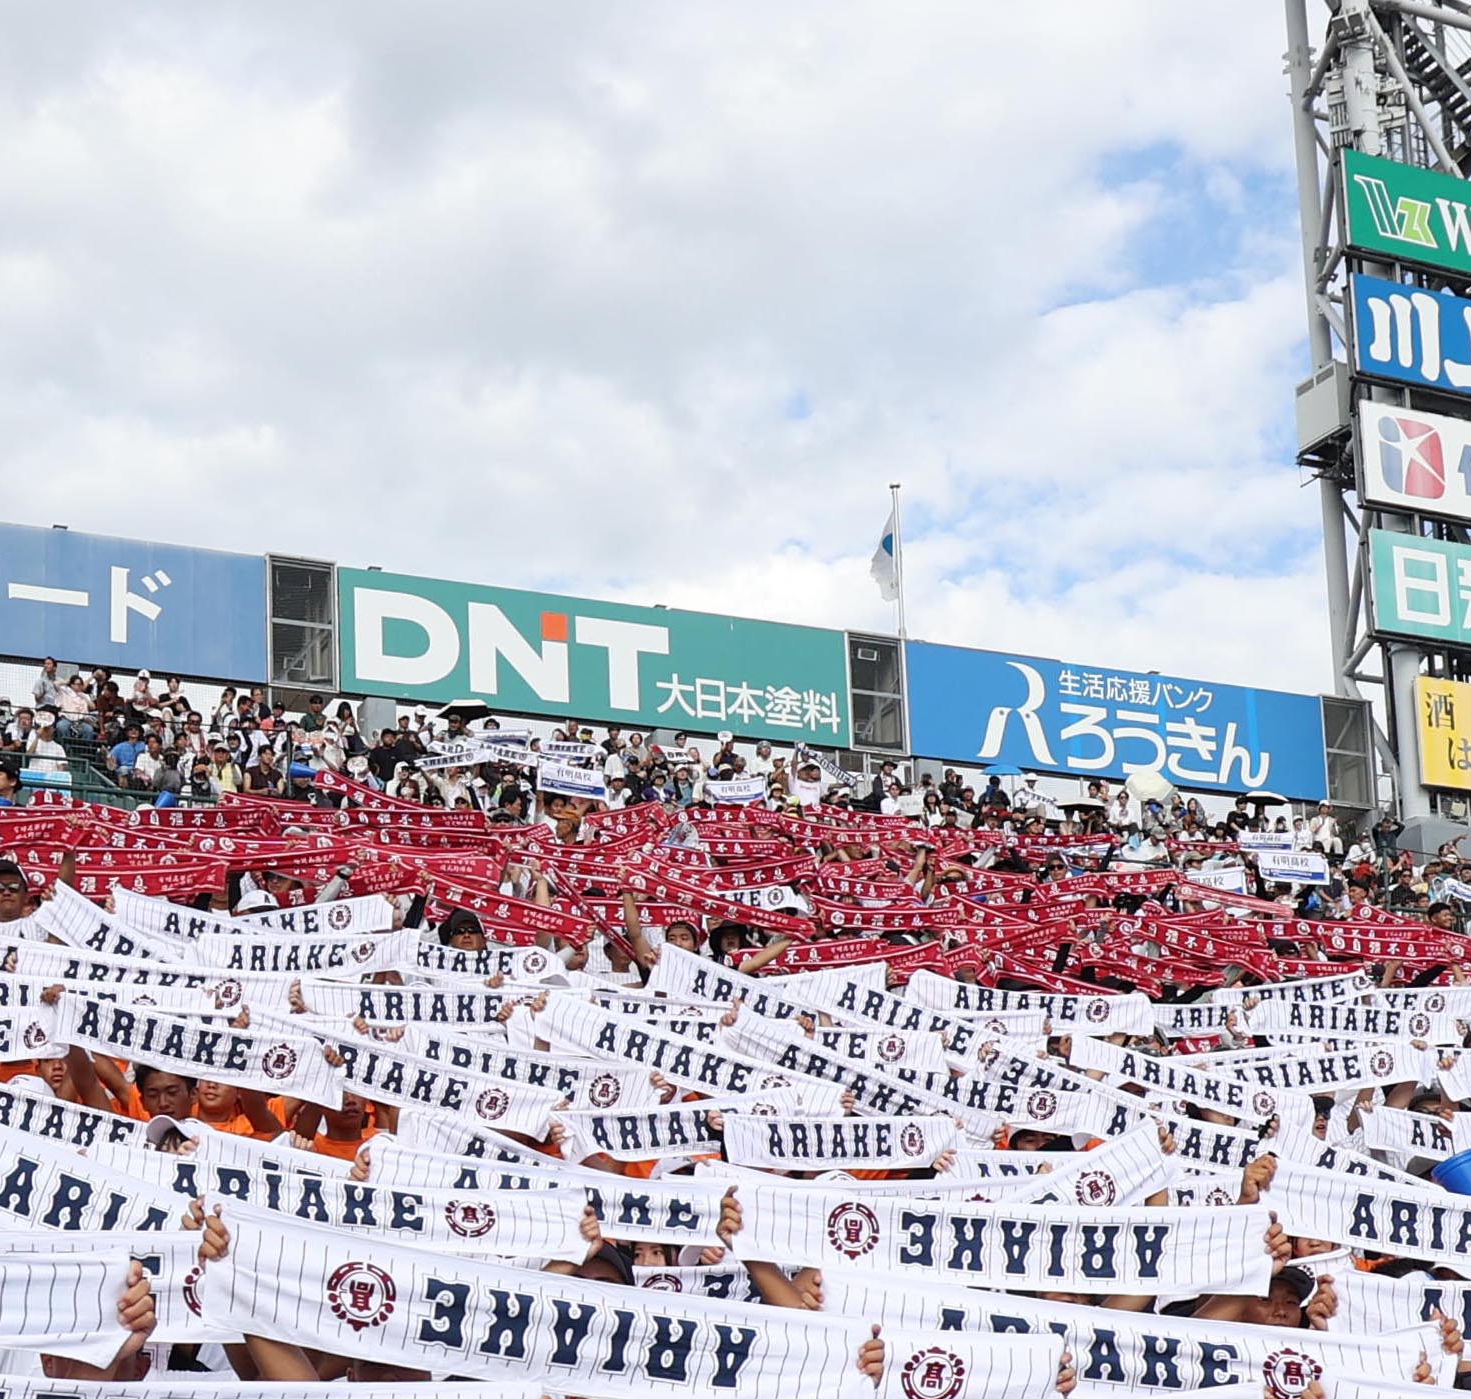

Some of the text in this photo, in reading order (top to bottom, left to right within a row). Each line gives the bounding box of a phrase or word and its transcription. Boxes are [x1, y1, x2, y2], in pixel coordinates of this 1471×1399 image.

[354, 586, 670, 712] DNT
[655, 672, 841, 734] 大日本塗料
[1058, 669, 1213, 713] 生活応援バンク
[557, 768, 591, 782] 有明高校
[1061, 704, 1270, 788] ろうきん
[1272, 854, 1309, 867] 有明高校
[228, 944, 345, 971] ARIAKE
[360, 991, 502, 1021] ARIAKE
[838, 982, 972, 1053] ARIAKE
[955, 984, 1076, 1020] ARIAKE
[1174, 1009, 1229, 1030] ARIA
[1289, 1003, 1400, 1034] ARIAKE
[77, 1002, 253, 1071] ARIAKE
[596, 1022, 753, 1093] ARIAKE
[335, 1042, 469, 1110] RIAKE
[779, 1045, 917, 1115] ARIAKE
[1120, 1054, 1244, 1108] ARIAKE
[1235, 1055, 1362, 1088] ARIAKE
[593, 1112, 719, 1153] ARIAK
[769, 1122, 892, 1158] ARIAKE
[1109, 1105, 1257, 1168] AIAKE
[173, 1163, 423, 1231] ARIAKE
[454, 1167, 699, 1230] AAKE
[900, 1212, 1170, 1279] ARIAKE
[421, 1280, 758, 1389] ARIAKE
